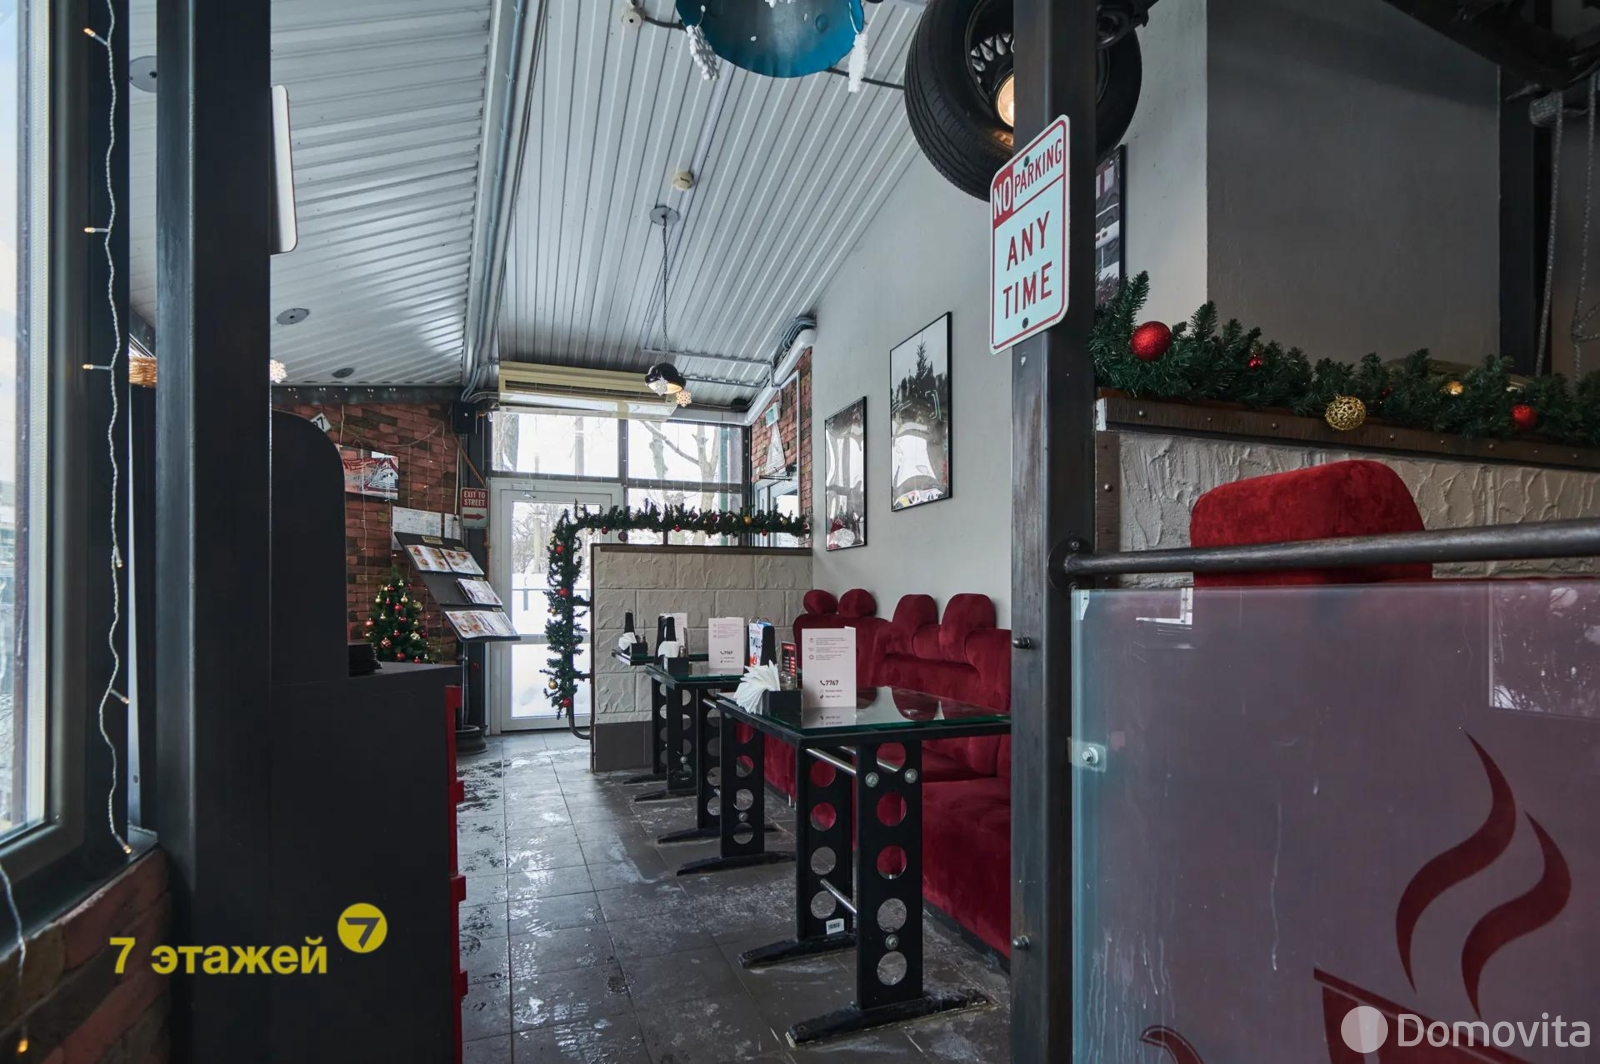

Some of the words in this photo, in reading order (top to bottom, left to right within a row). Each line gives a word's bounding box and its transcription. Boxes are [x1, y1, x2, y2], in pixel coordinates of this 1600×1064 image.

[993, 177, 1011, 220] NO
[1014, 138, 1063, 198] PARKING
[1006, 210, 1052, 272] ANY
[1002, 260, 1053, 320] TIME
